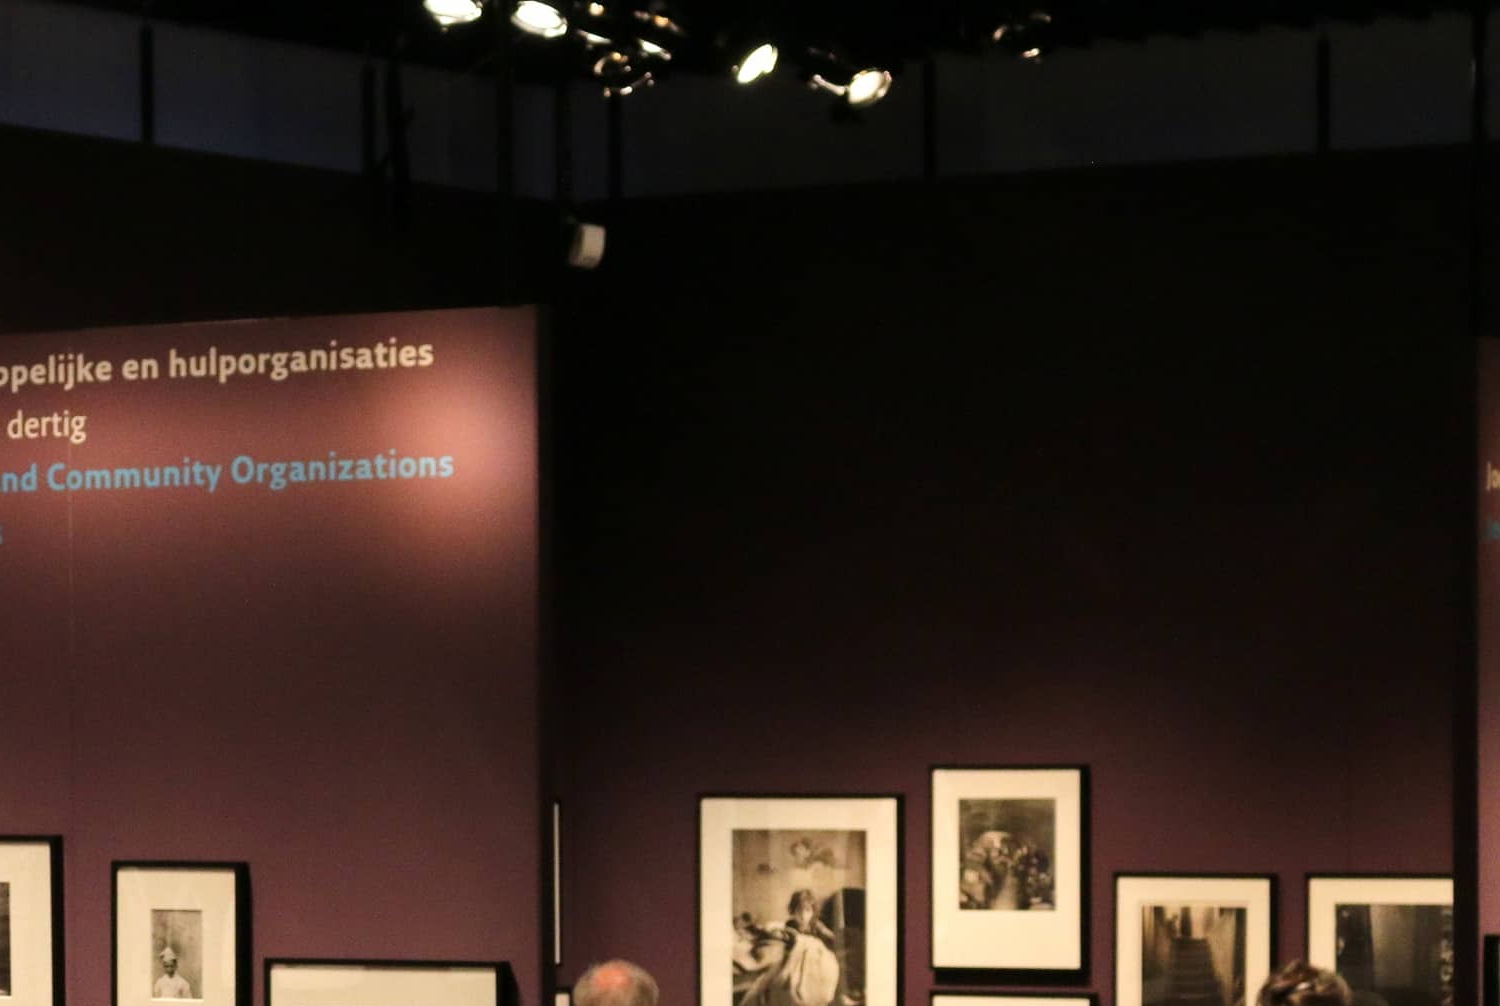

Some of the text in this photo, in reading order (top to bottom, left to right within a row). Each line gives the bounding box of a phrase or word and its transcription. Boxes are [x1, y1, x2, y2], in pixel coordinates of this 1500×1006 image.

[121, 357, 159, 381] en
[168, 337, 435, 384] hulporganisaties
[7, 409, 87, 444] dertig
[46, 456, 222, 492] Community
[230, 449, 454, 491] Organizations
